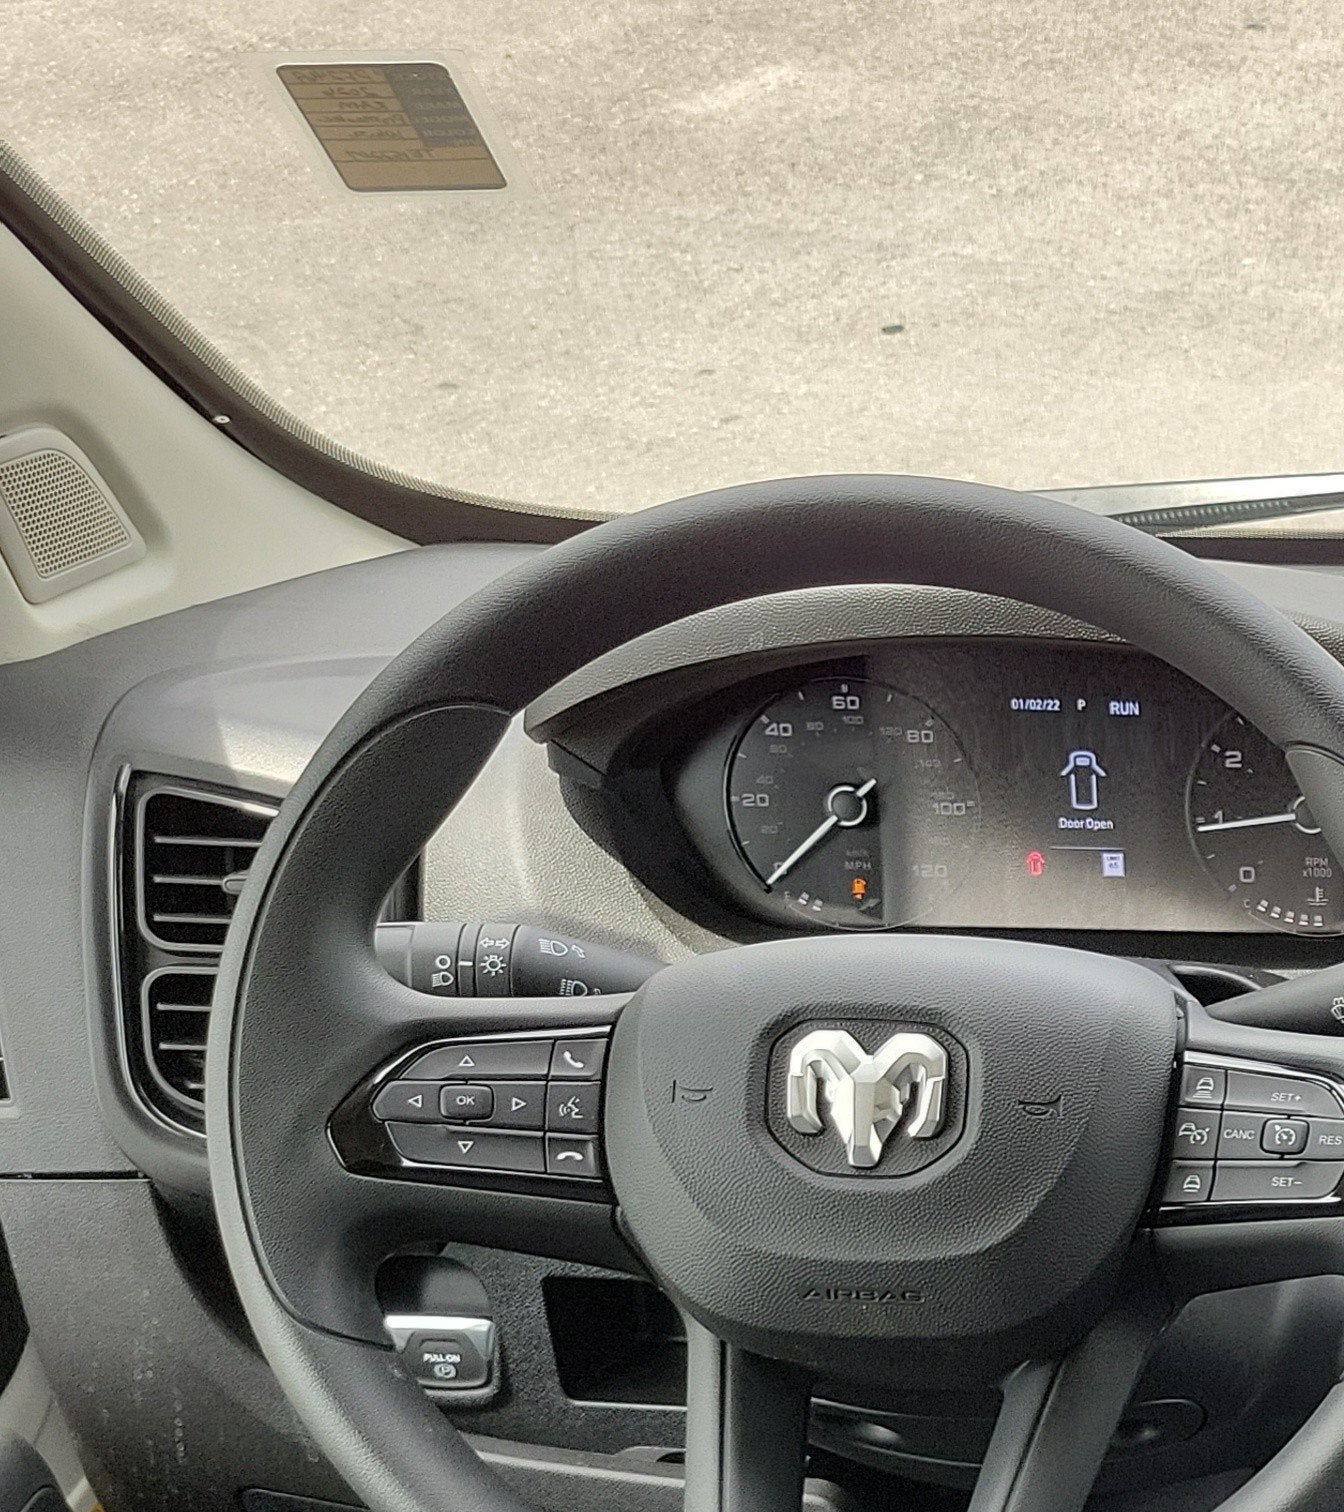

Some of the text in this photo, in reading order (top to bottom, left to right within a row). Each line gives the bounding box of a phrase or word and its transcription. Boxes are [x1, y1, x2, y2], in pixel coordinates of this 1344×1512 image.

[831, 696, 860, 710] 60
[1011, 698, 1140, 716] 01/02/22 P RUN
[765, 723, 793, 737] 40
[907, 729, 934, 743] 80
[1225, 751, 1242, 768] 2
[741, 793, 770, 807] 20
[932, 802, 966, 816] 100
[1214, 810, 1224, 824] 1
[1058, 817, 1114, 832] Door Open
[1305, 857, 1329, 867] RPM
[912, 863, 948, 878] 120
[1240, 866, 1255, 883] 0
[456, 1094, 476, 1106] OK
[1223, 1128, 1256, 1140] CANC
[1318, 1135, 1343, 1146] RES
[803, 1288, 926, 1304] AIRBAG
[423, 1353, 461, 1364] PULL ON
